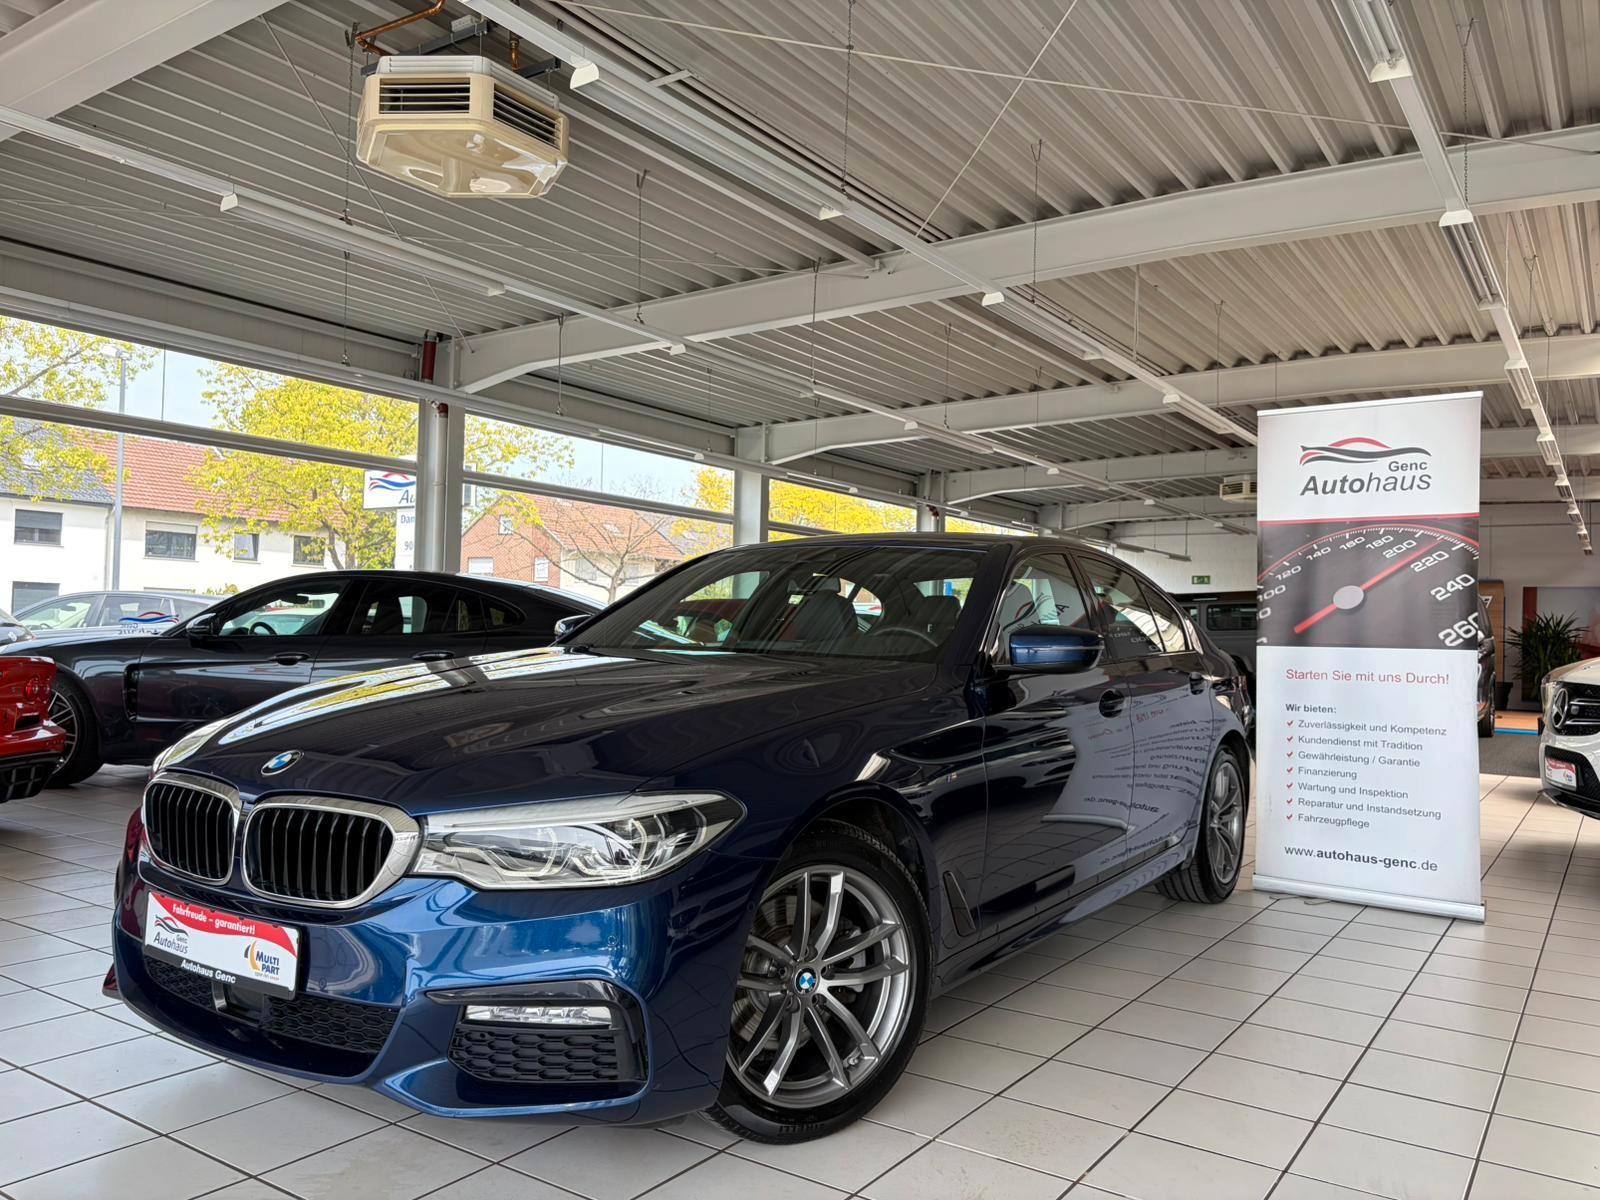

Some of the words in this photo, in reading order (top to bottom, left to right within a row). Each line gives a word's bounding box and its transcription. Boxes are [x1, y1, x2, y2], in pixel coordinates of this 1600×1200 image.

[1388, 460, 1428, 472] Genc
[1300, 472, 1433, 496] Autohaus
[1339, 537, 1365, 550] 160
[1366, 535, 1394, 550] 180
[1382, 539, 1417, 559] 200
[1306, 547, 1331, 560] 140
[1410, 550, 1450, 573] 220
[1275, 565, 1301, 580] 120
[1429, 573, 1475, 601] 240
[1257, 607, 1271, 620] 0
[1286, 669, 1328, 681] Starten
[1332, 670, 1352, 681] Sie
[1355, 672, 1374, 682] mit
[1378, 674, 1401, 683] uns
[1405, 672, 1449, 684] Durch!
[1285, 704, 1301, 712] Wir
[1303, 704, 1337, 714] bieten:
[1298, 720, 1367, 732] Zuverlässigkeit
[1369, 724, 1387, 732] und
[1390, 725, 1447, 736] Kompetenz
[1298, 736, 1361, 747] Kundendienst
[1364, 740, 1378, 748] mit
[1381, 740, 1423, 751] Tradition
[1298, 751, 1369, 765] Gewährleistung
[1378, 756, 1420, 767] Garantie
[1298, 767, 1357, 780] Finanzierung
[1298, 782, 1336, 795] Wartung
[1339, 787, 1357, 795] und
[1359, 787, 1409, 799] Inspektion
[1298, 798, 1343, 809] Reparatur
[1346, 803, 1364, 811] und
[1367, 804, 1441, 820] Instandsetzung
[1298, 813, 1370, 829] Fahrzeugpflege
[1285, 846, 1438, 871] www.autohaus-genc.de
[172, 904, 208, 923] Fahrfreude
[153, 931, 189, 954] Autohaus
[256, 950, 280, 967] MULTI
[180, 959, 214, 978] Autohaus
[214, 970, 237, 984] Genc
[261, 963, 281, 976] PART
